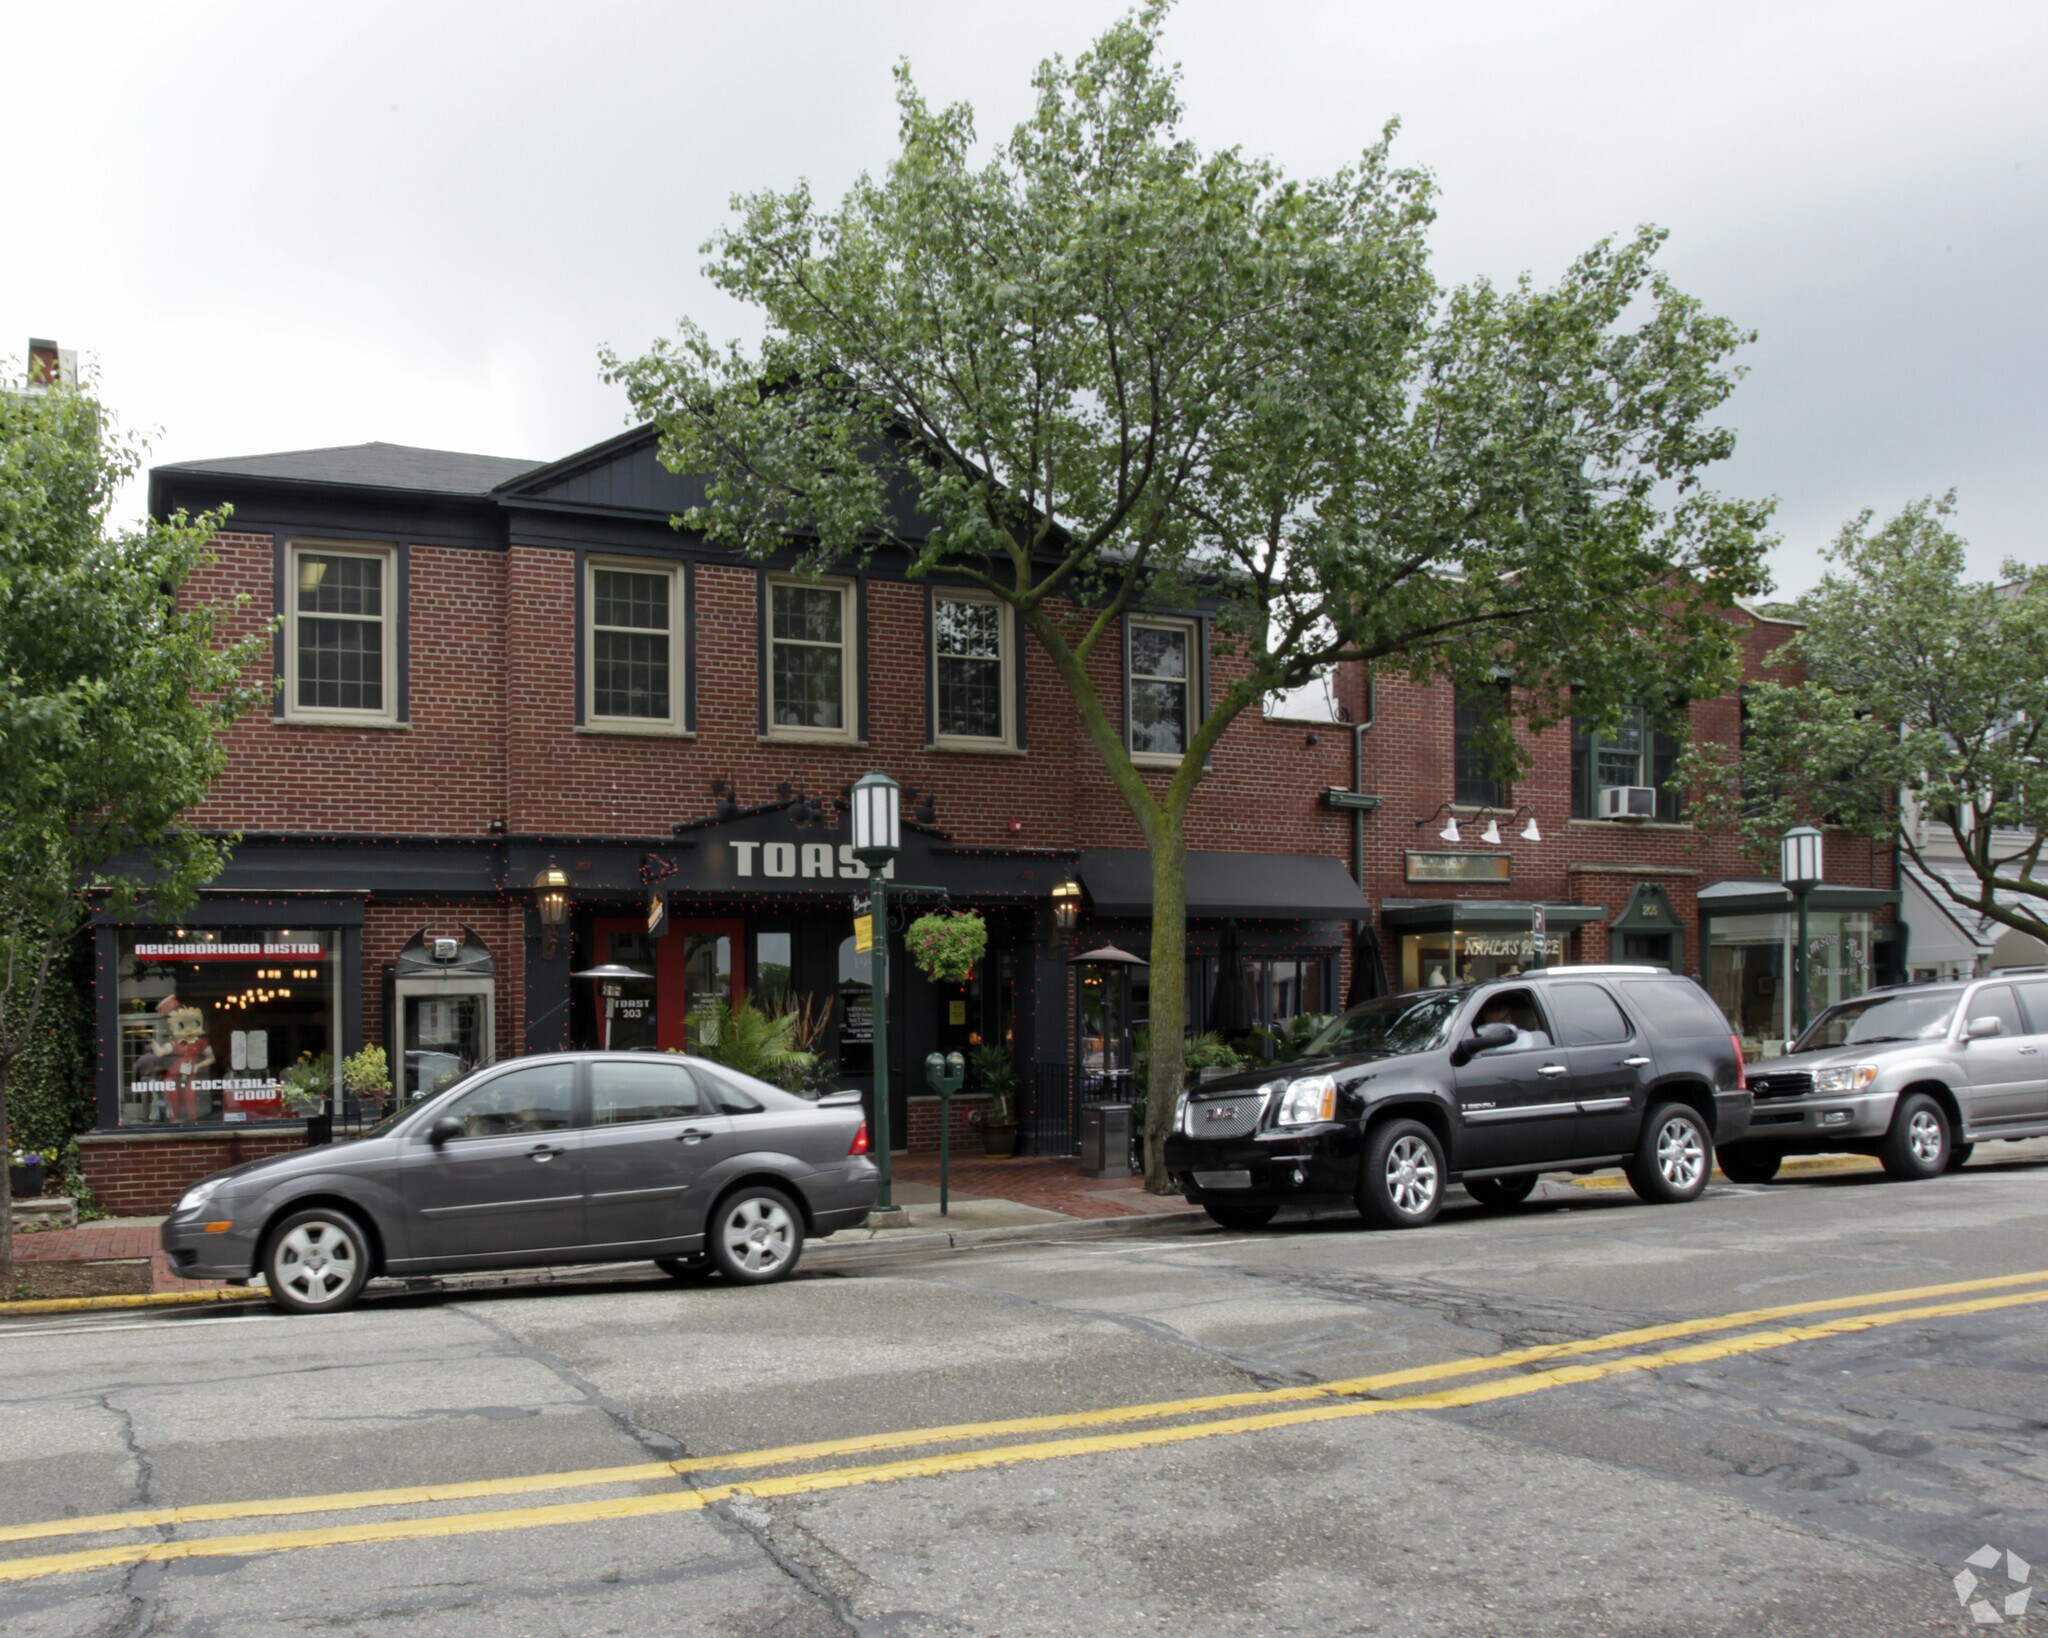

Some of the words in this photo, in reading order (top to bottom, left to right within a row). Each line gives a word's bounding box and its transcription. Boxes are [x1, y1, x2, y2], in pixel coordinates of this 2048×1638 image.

[729, 841, 895, 879] TOAS
[264, 943, 320, 954] BISTRO
[1521, 939, 1560, 955] PLCE
[623, 1009, 641, 1018] 203
[234, 1090, 277, 1101] GOOD
